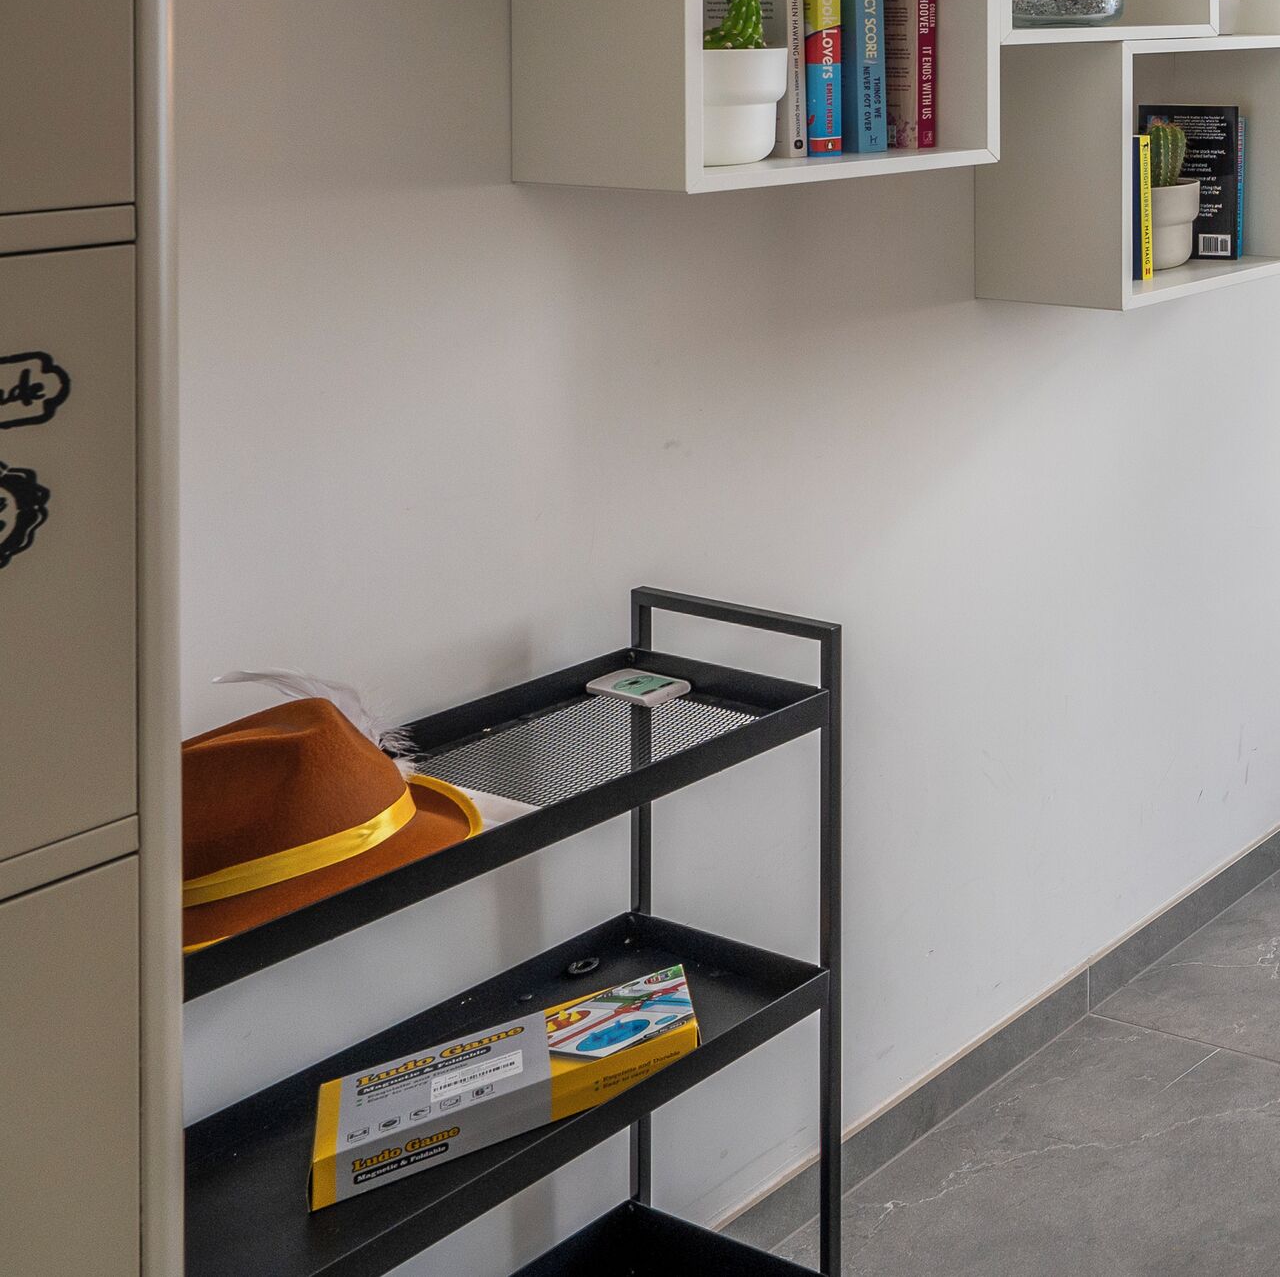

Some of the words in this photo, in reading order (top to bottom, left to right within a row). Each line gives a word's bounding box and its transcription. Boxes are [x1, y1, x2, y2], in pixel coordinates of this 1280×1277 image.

[792, 19, 800, 57] HAWKING
[864, 18, 878, 59] SCORE
[922, 46, 932, 54] IT
[822, 29, 838, 79] Lovers
[863, 66, 871, 91] NEVER
[922, 57, 932, 80] ENDS
[873, 76, 882, 104] THINGS
[922, 82, 932, 106] WITH
[864, 111, 872, 132] OVER
[874, 107, 882, 119] WE
[922, 108, 932, 119] US
[355, 1055, 436, 1089] Ludo
[439, 1025, 525, 1059] Game
[362, 1071, 421, 1094] Magnetic
[437, 1048, 488, 1068] Foldable
[352, 1146, 402, 1173] Ludo
[404, 1126, 461, 1153] Game
[356, 1162, 398, 1183] Magnetic
[410, 1145, 447, 1162] Foldable
